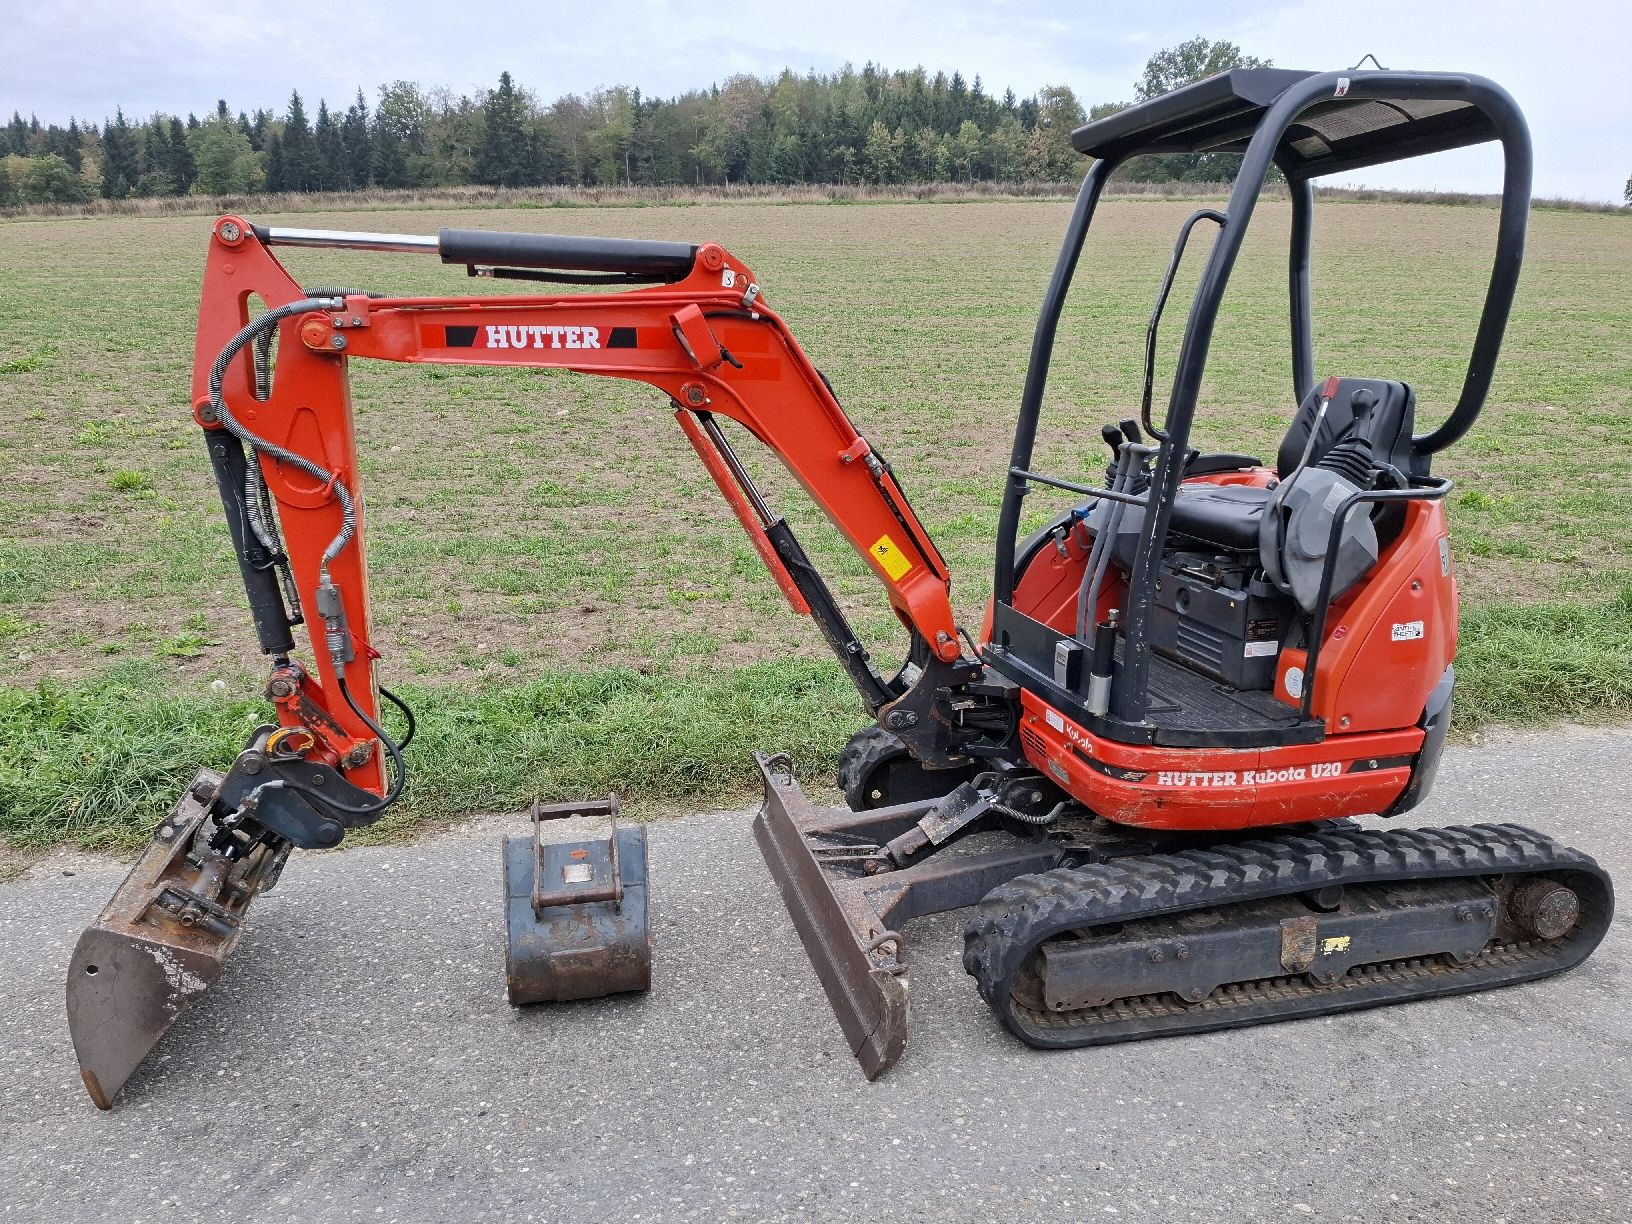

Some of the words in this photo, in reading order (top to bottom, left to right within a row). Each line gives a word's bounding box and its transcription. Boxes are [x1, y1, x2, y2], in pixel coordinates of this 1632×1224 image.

[485, 325, 601, 349] HUTTER
[1157, 771, 1236, 787] HUTTER
[1242, 768, 1306, 785] Kubota
[1311, 762, 1342, 779] U20
